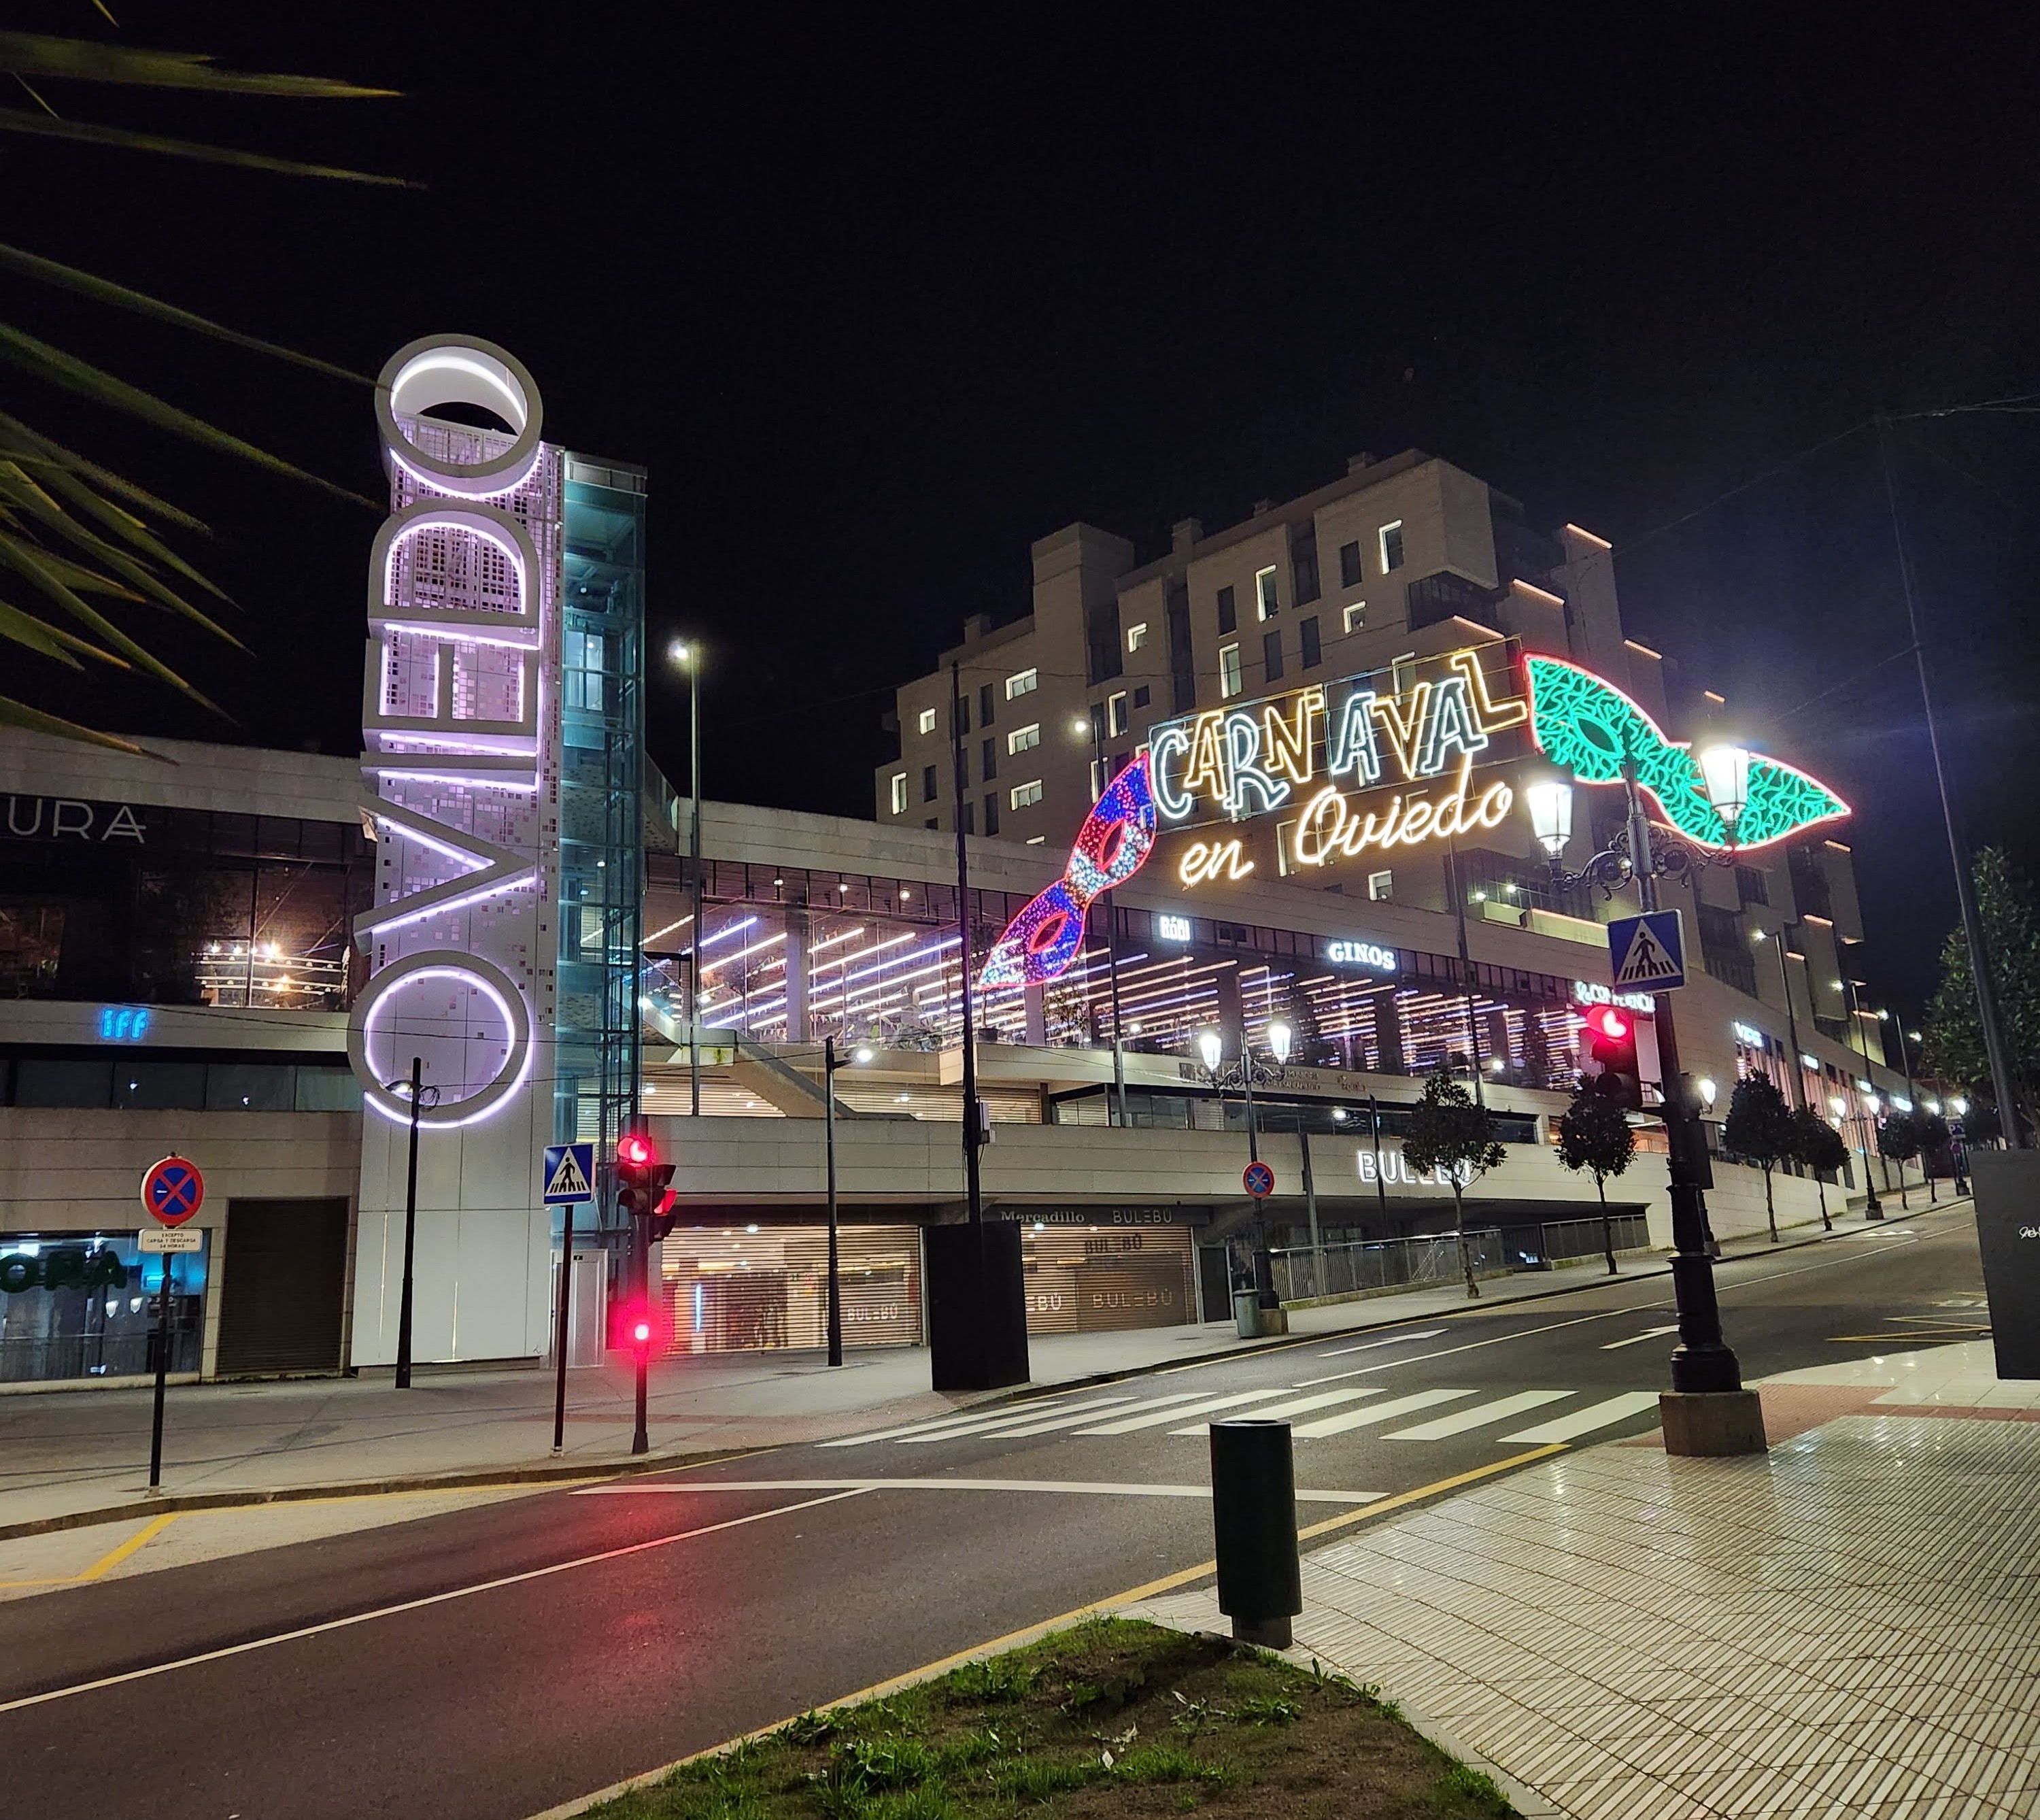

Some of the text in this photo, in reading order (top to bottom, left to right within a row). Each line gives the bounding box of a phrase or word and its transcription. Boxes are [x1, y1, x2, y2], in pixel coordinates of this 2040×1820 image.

[347, 333, 544, 1126] OVIEDO
[1153, 651, 1528, 820] CARNAVAL
[8, 796, 147, 844] URA
[1179, 754, 1514, 885] en Oviedo
[1328, 941, 1396, 971] GINOS
[1001, 1211, 1085, 1224] Mercadillo
